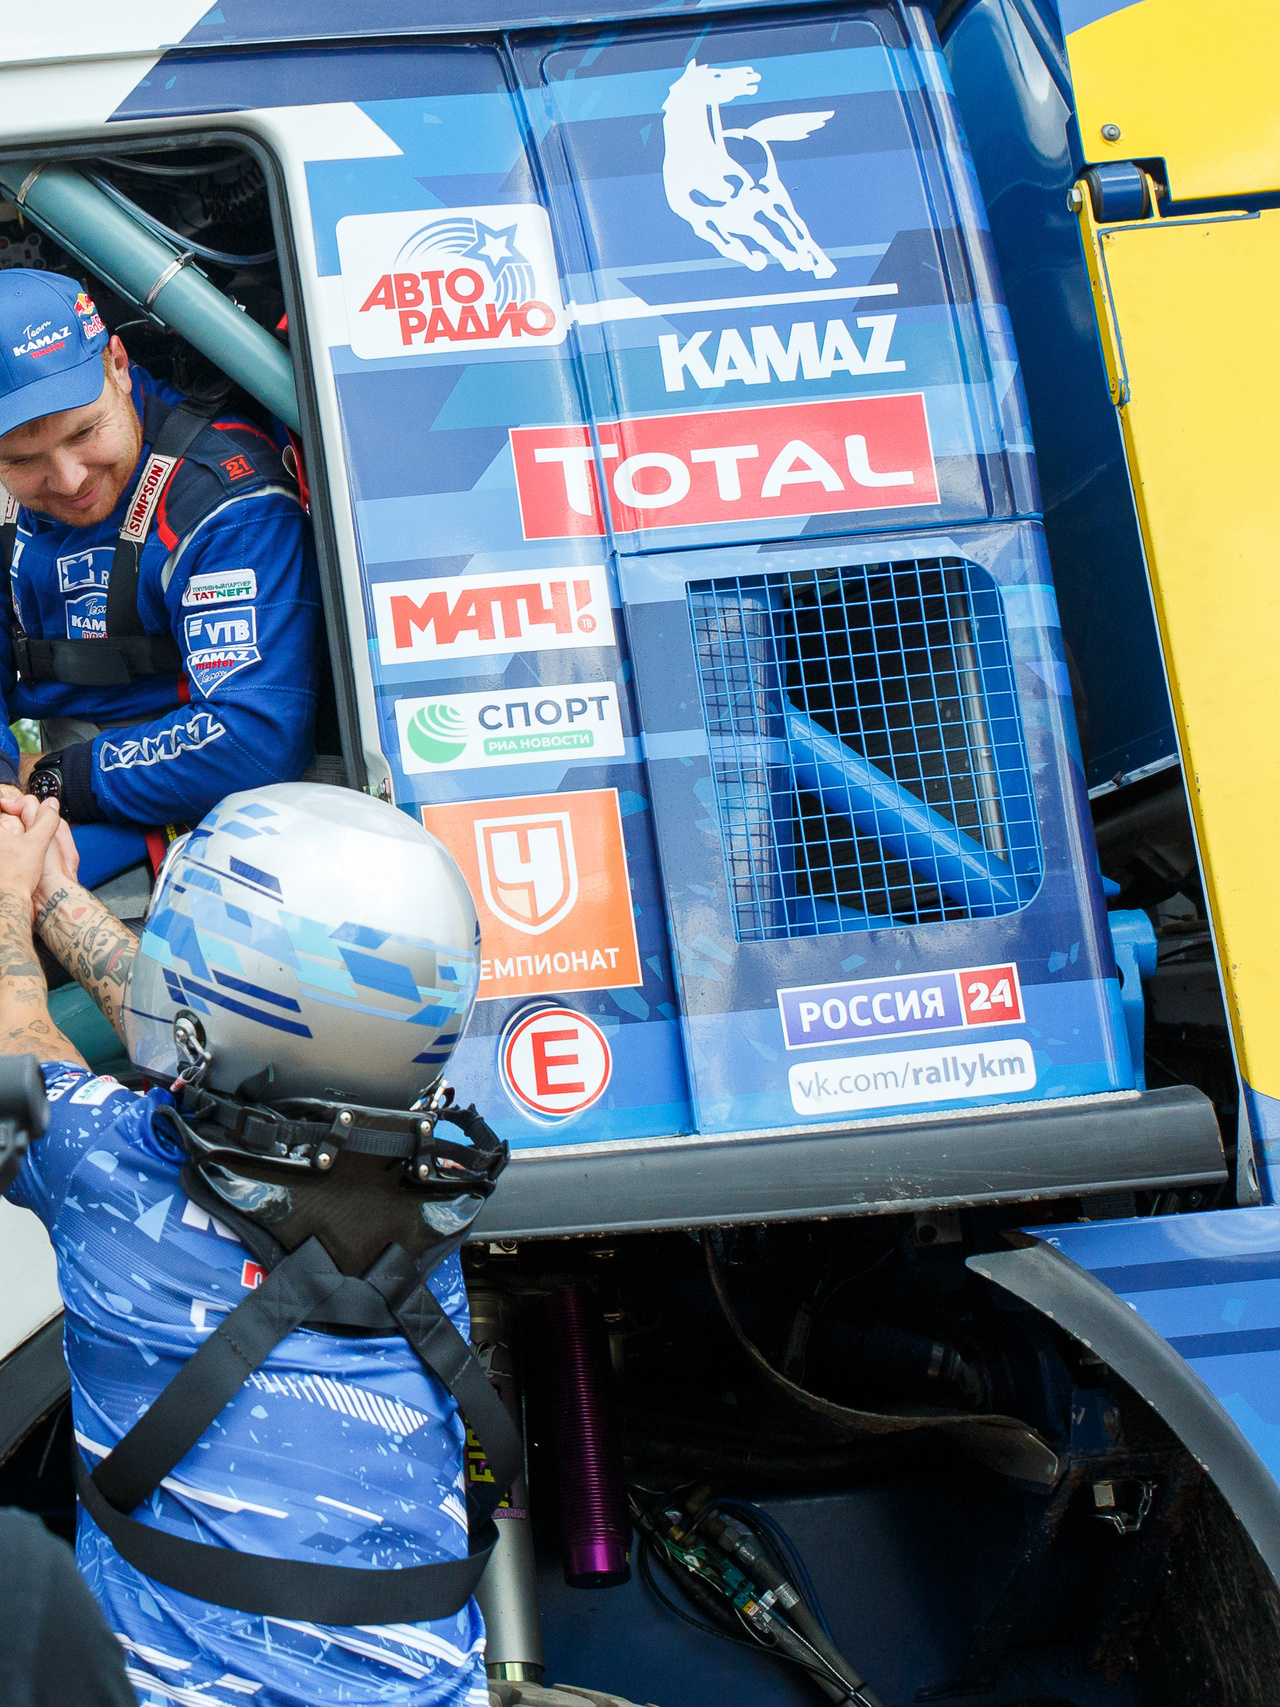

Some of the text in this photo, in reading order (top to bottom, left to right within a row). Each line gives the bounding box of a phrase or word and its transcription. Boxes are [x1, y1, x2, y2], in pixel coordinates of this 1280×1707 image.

[359, 267, 485, 313] АВТО
[23, 321, 52, 340] Team
[398, 300, 556, 346] РАДИО
[12, 326, 72, 357] KAMAZ
[30, 341, 65, 359] master
[658, 314, 907, 392] KAMAZ
[225, 457, 250, 478] 21
[533, 434, 915, 516] TOTAL
[129, 464, 164, 533] SIMPSON
[193, 586, 252, 601] TATNEFT
[71, 615, 107, 631] KAM
[204, 619, 250, 645] VTB
[191, 651, 250, 666] KAMAZ
[196, 659, 236, 671] master
[478, 696, 610, 731] СПОРТ
[488, 734, 590, 752] РИА НОВОСТИ
[480, 948, 620, 981] ЕМПИОНАТ
[799, 978, 1014, 1033] РОССИЯ 24
[531, 1029, 585, 1096] E
[797, 1053, 1026, 1098] vk.com/rallykm
